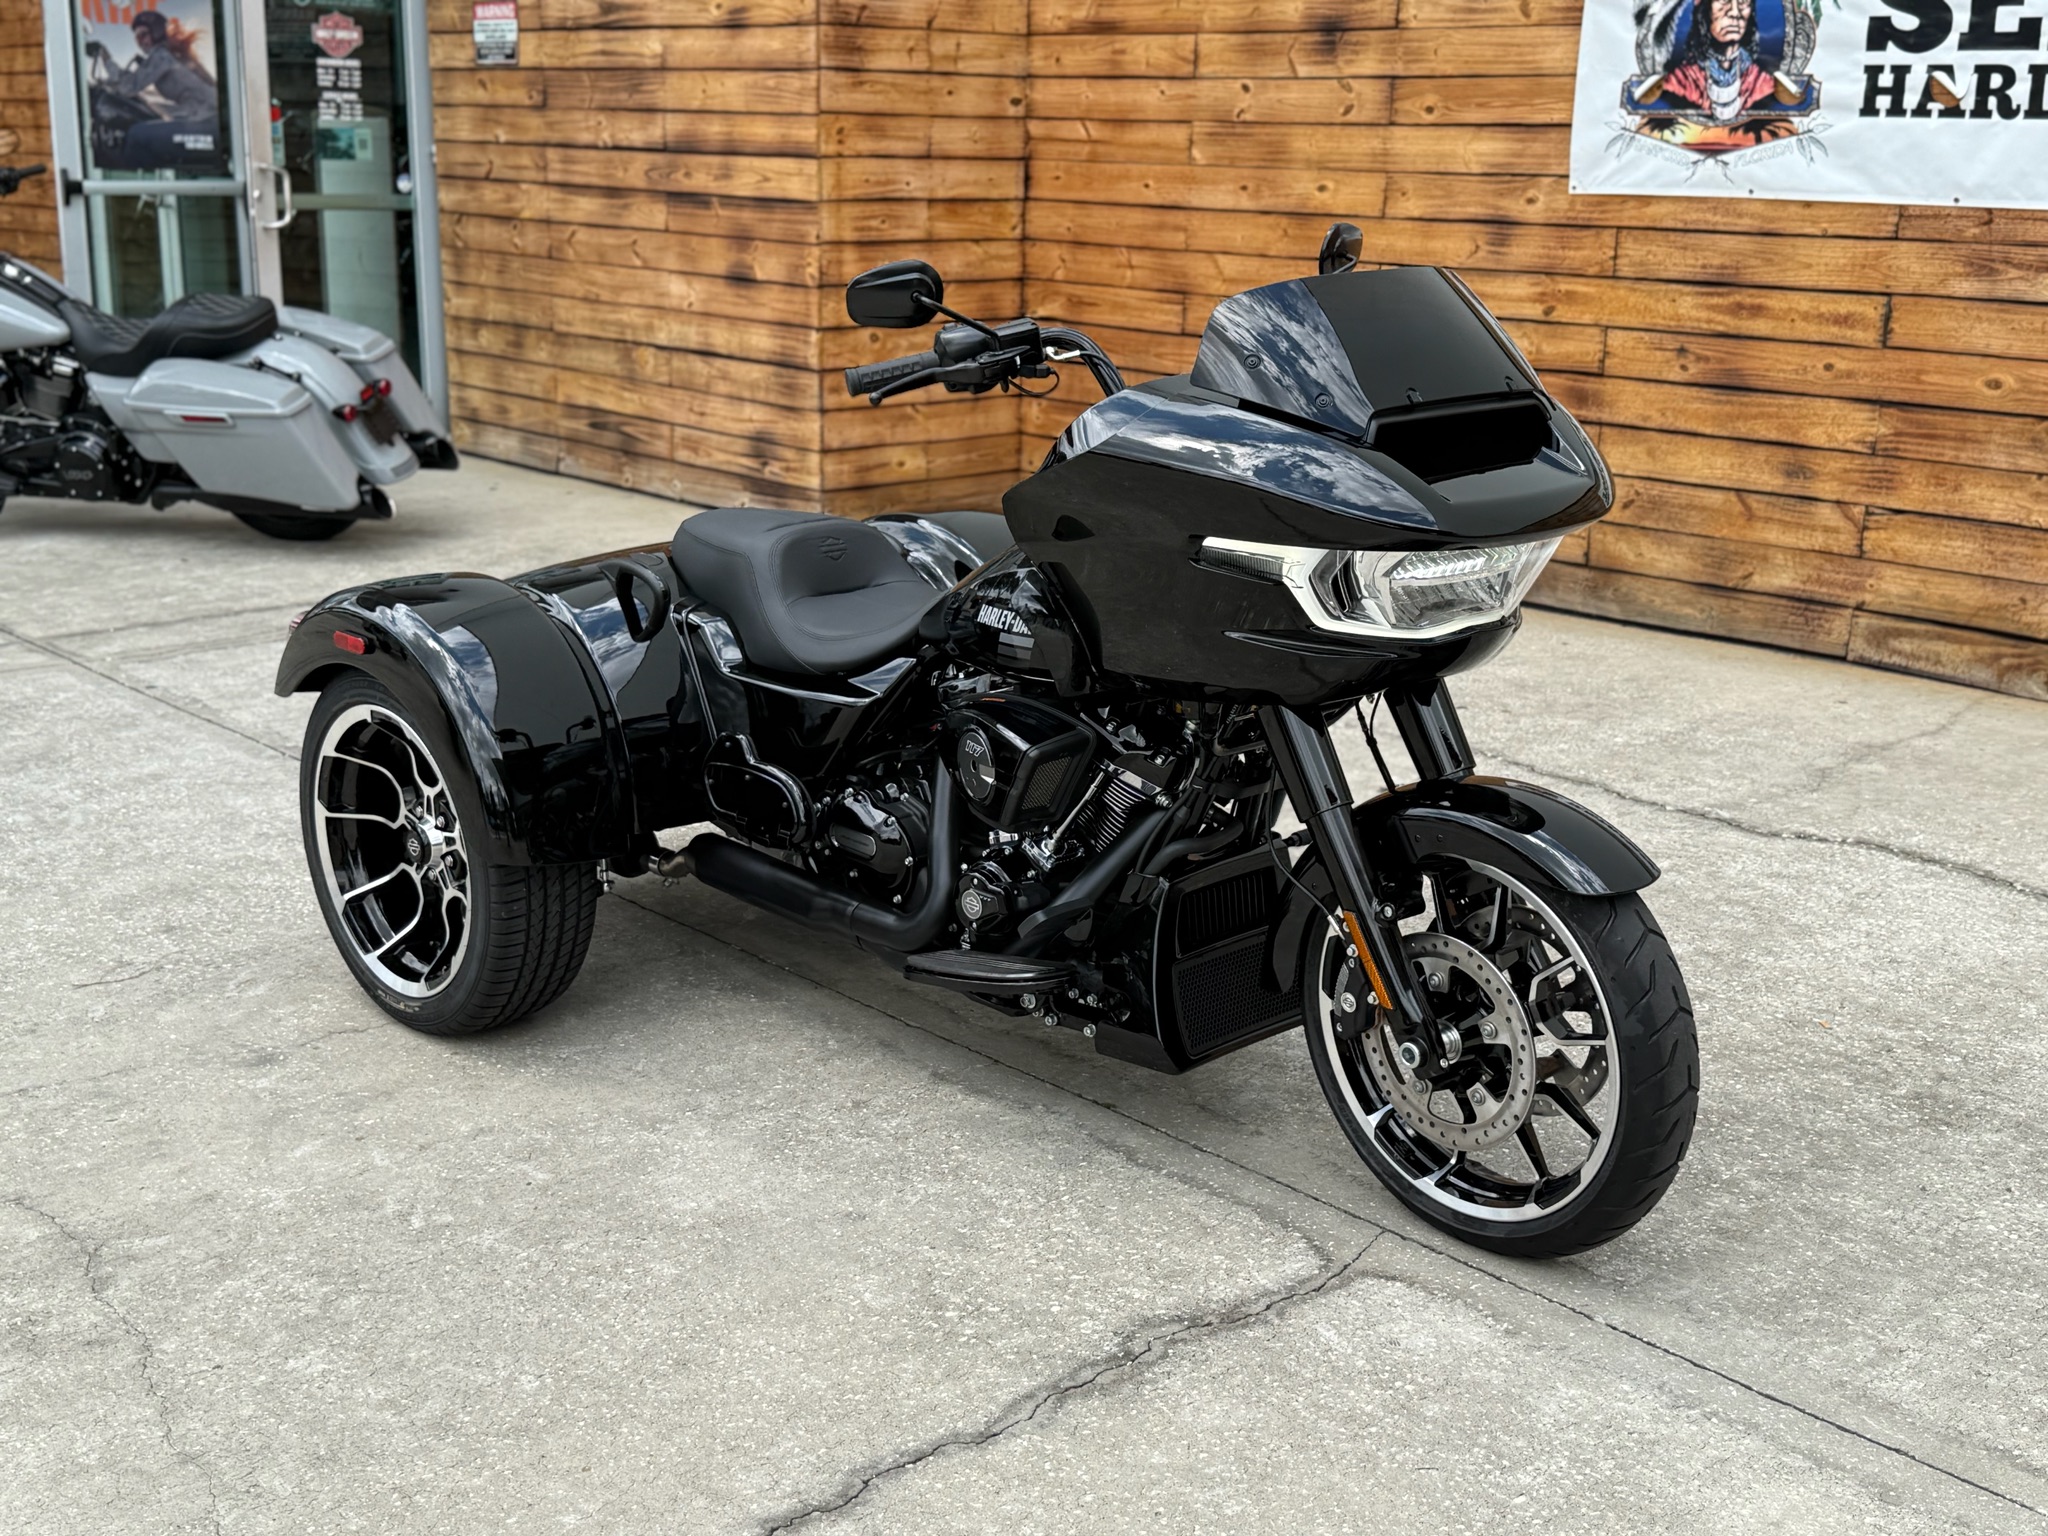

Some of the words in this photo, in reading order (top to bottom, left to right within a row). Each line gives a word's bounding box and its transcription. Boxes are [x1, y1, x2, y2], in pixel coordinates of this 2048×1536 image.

[1866, 0, 2048, 54] SE
[1734, 142, 1793, 168] FLORIDA
[977, 604, 1032, 635] HARLEY-DA
